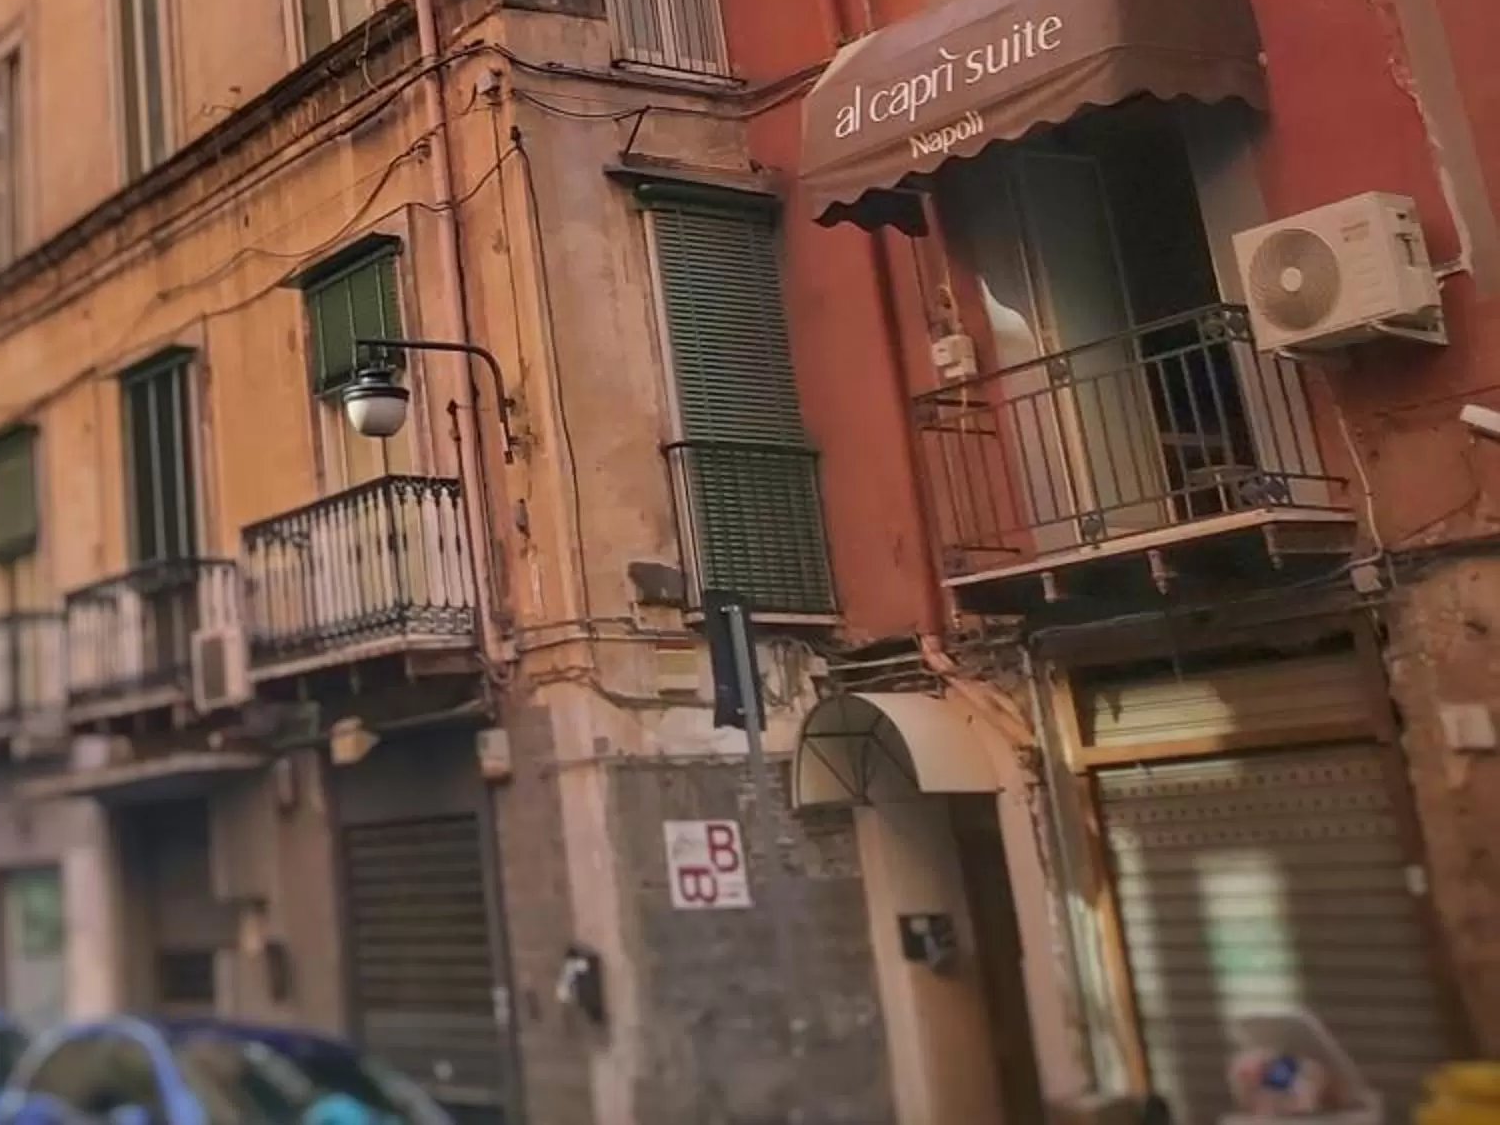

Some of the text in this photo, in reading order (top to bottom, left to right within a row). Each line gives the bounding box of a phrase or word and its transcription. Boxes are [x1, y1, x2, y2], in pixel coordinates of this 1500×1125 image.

[835, 84, 862, 138] al
[964, 15, 1063, 84] suite
[909, 110, 984, 159] Napoli
